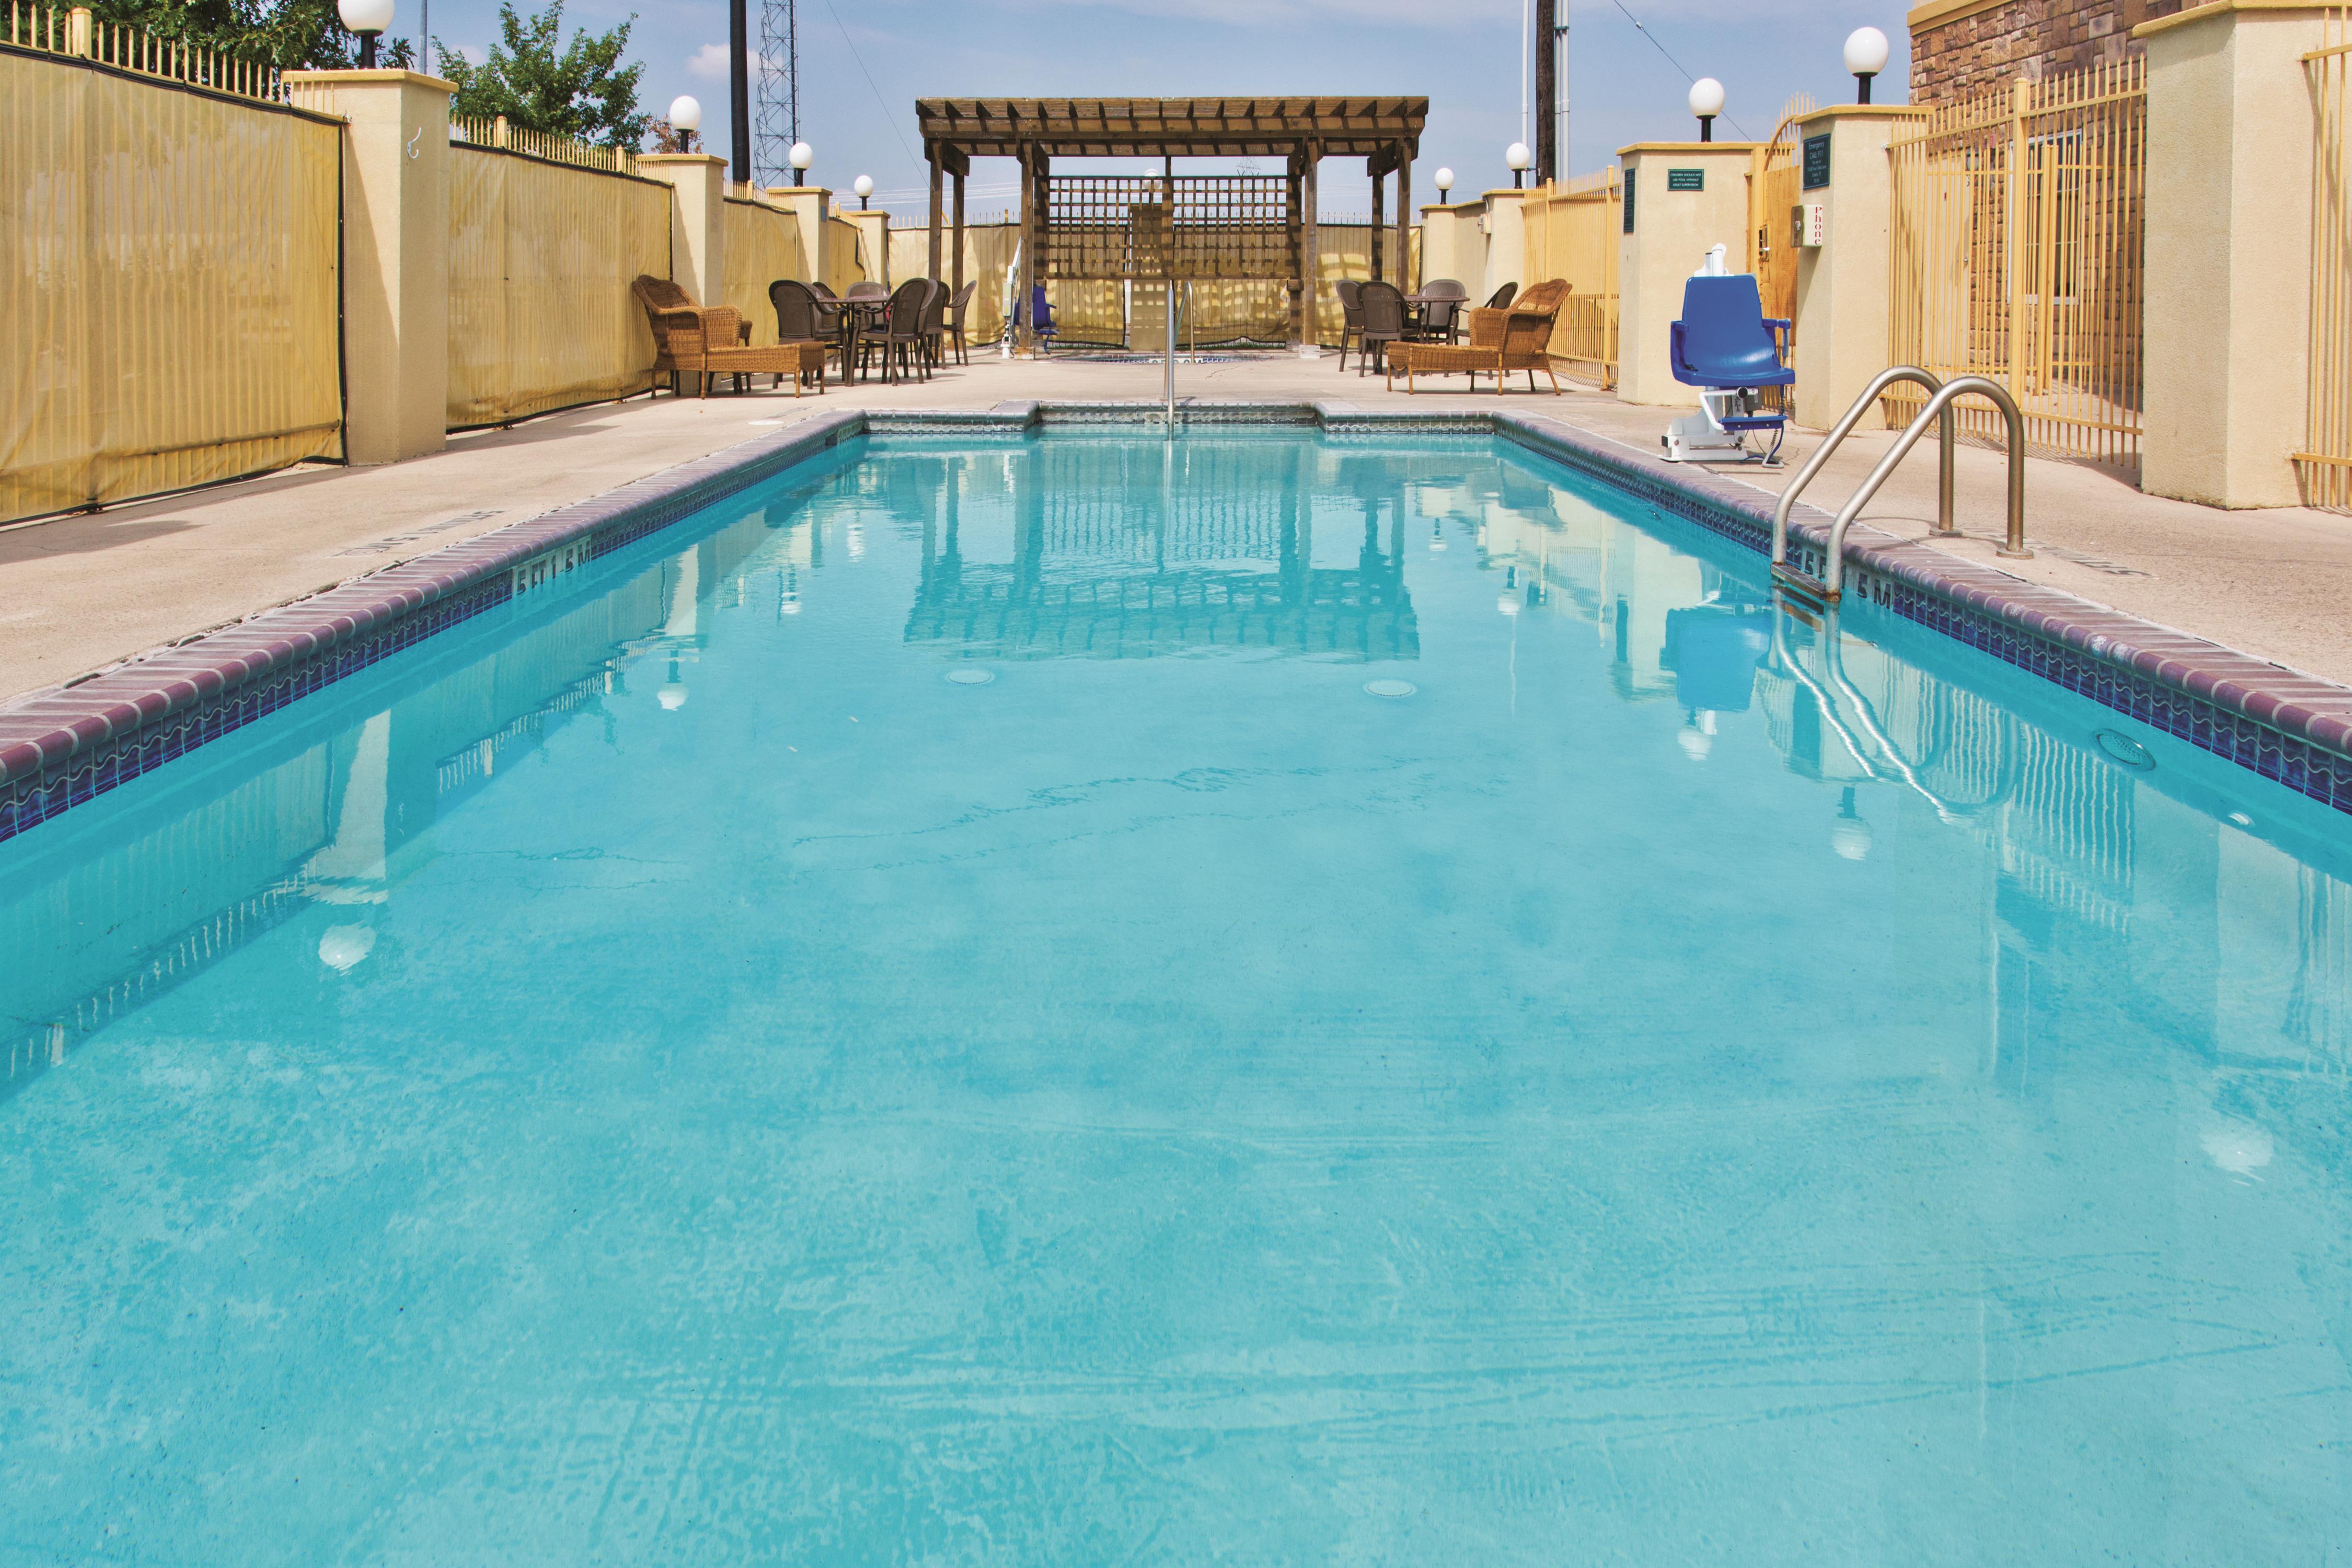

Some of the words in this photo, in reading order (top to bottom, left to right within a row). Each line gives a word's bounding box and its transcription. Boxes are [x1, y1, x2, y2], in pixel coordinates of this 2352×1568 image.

[1808, 142, 1824, 150] Emergency
[516, 569, 526, 595] 5
[532, 560, 547, 589] FT
[578, 540, 590, 567] M
[1804, 551, 1814, 575] 5
[1873, 579, 1892, 609] M
